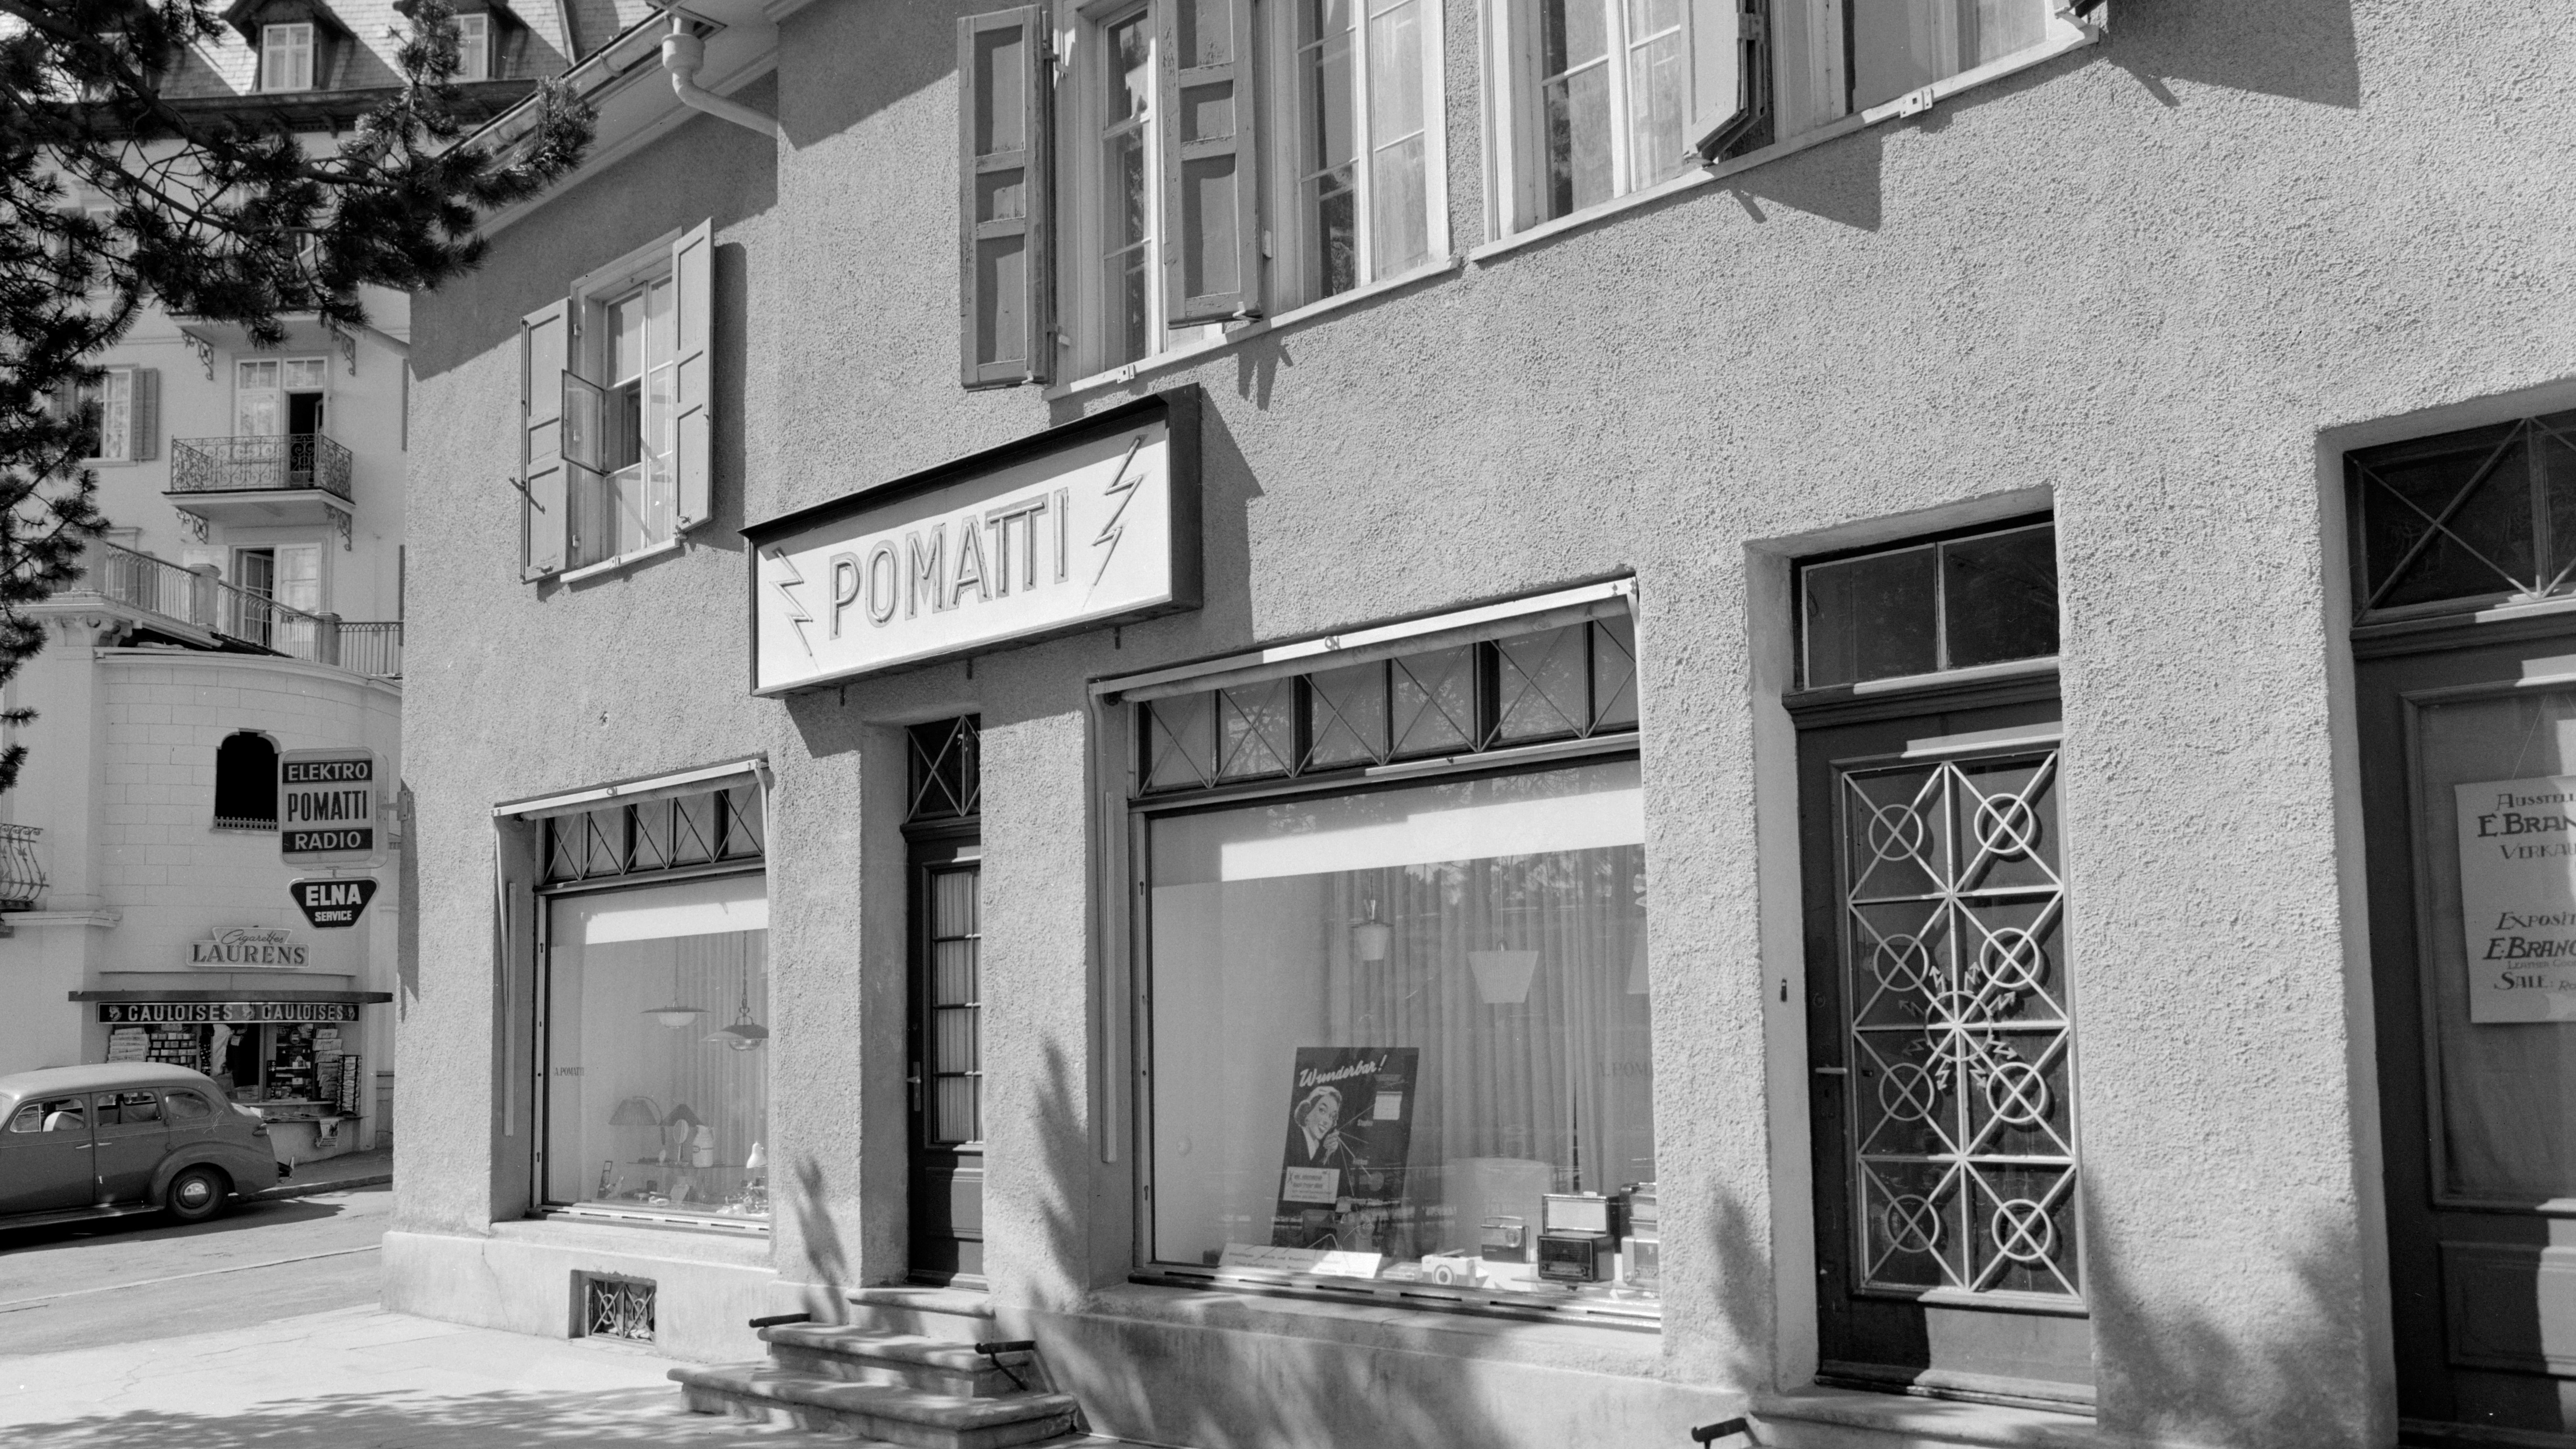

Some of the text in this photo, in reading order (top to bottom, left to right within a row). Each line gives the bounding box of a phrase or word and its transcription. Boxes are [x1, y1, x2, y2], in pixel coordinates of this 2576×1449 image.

[829, 486, 1069, 640] POMATTI
[288, 762, 368, 781] ELEKTRO
[288, 791, 367, 822] POMATTI
[295, 831, 361, 850] RADIO
[306, 884, 362, 906] ELNA
[315, 910, 352, 922] SERVICE
[221, 929, 283, 945] Cigarettes
[193, 944, 306, 965] LAURENS
[128, 1005, 233, 1021] GAULOISES
[262, 1004, 343, 1020] GAULOISES
[1299, 1054, 1387, 1087] Wunderbar!
